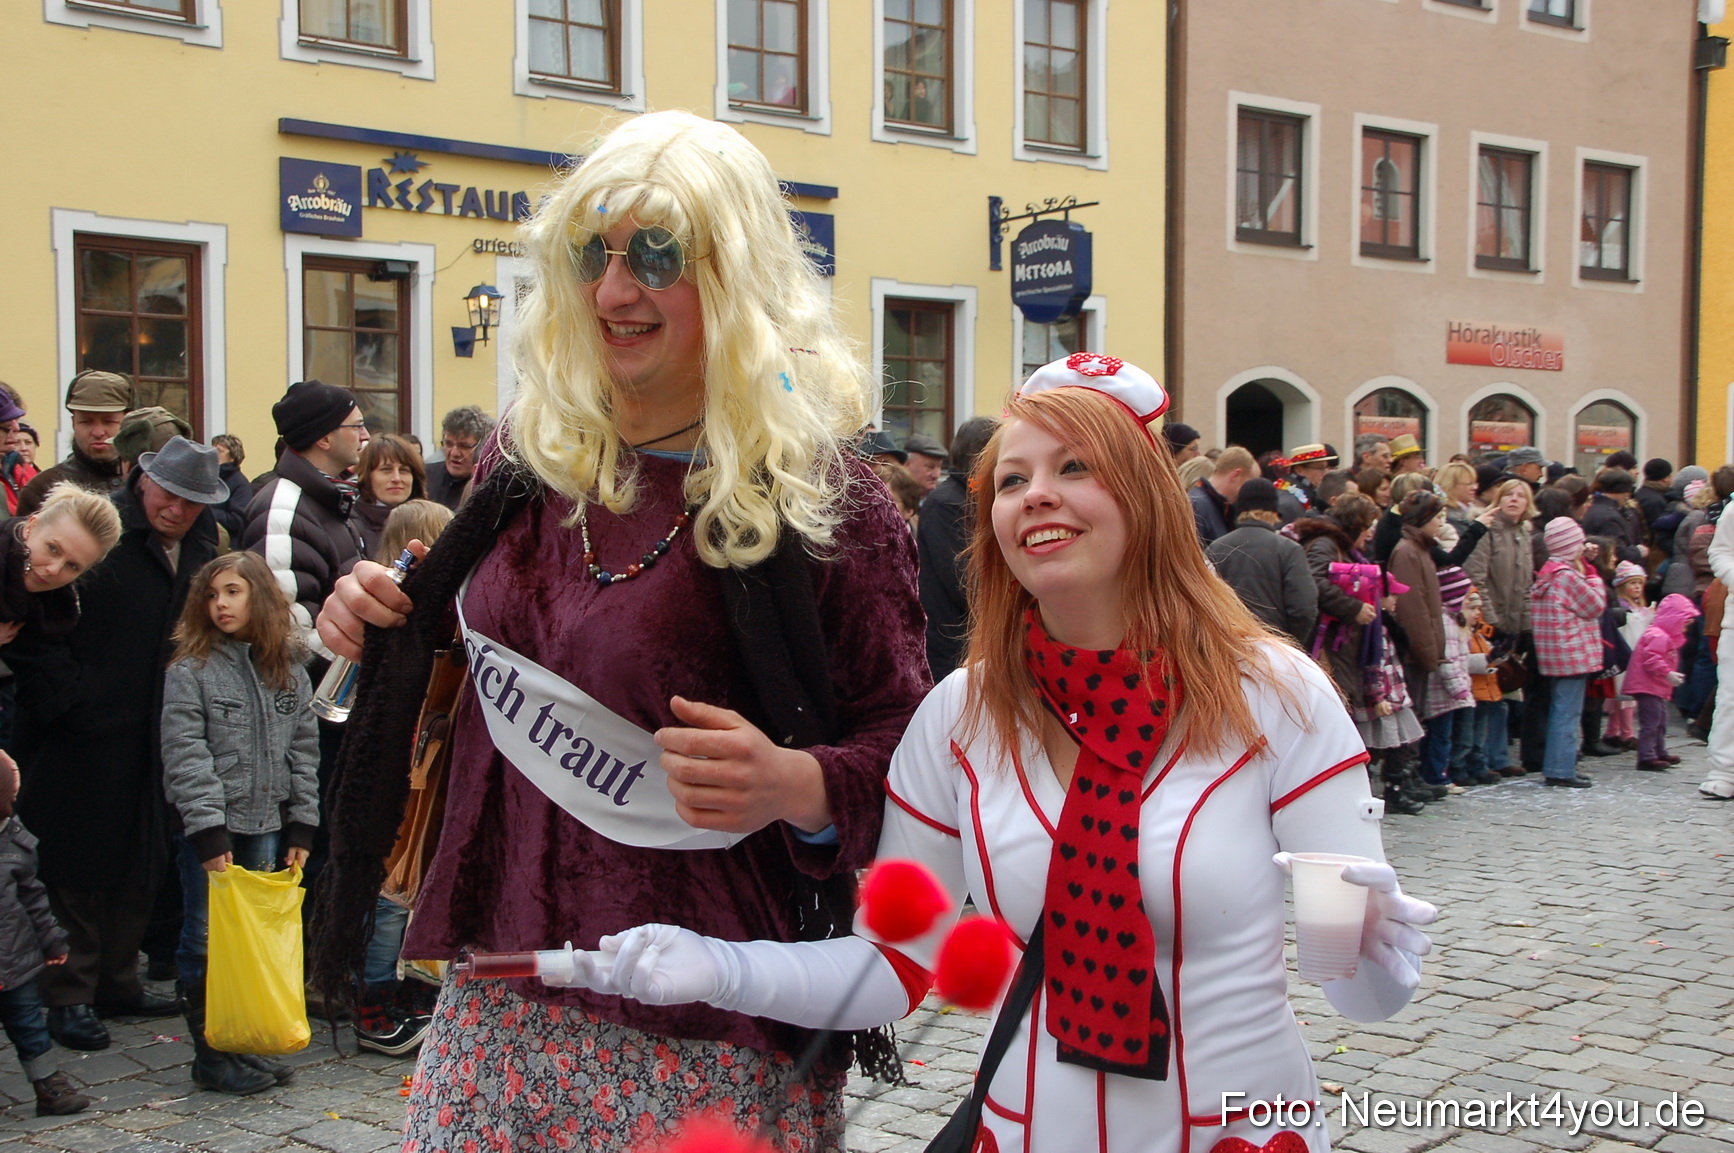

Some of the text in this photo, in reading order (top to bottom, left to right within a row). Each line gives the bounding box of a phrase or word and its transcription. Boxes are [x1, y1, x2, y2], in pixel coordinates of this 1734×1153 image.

[287, 193, 353, 217] Arcobräu
[1448, 321, 1542, 348] Hörakustik
[528, 702, 648, 806] traut
